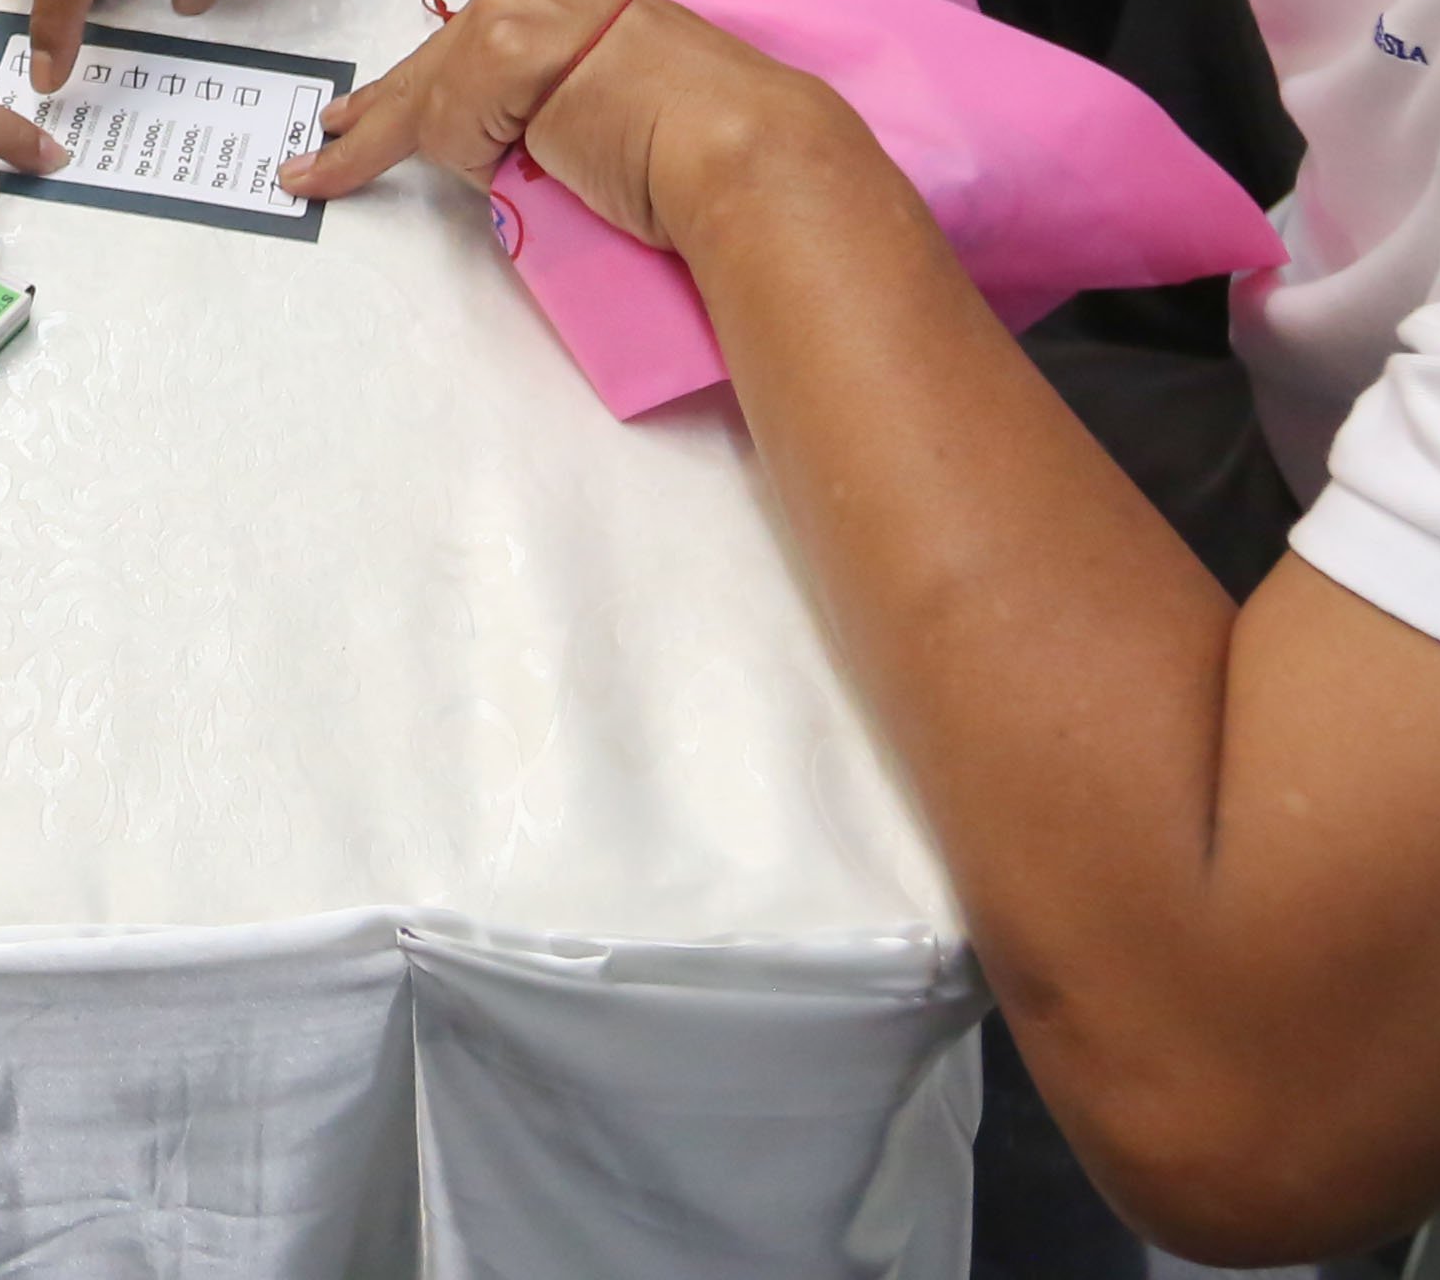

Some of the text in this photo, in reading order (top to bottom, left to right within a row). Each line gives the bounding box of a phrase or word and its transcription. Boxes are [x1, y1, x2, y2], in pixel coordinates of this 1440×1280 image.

[64, 101, 91, 148] 20.000,-
[96, 109, 127, 172] Rp 10.000,-
[134, 118, 163, 177] Rp 5.000,-
[173, 123, 199, 183] Rp 2.000,-
[211, 132, 237, 189] Rp 1.000,-
[249, 156, 271, 195] TOTAL
